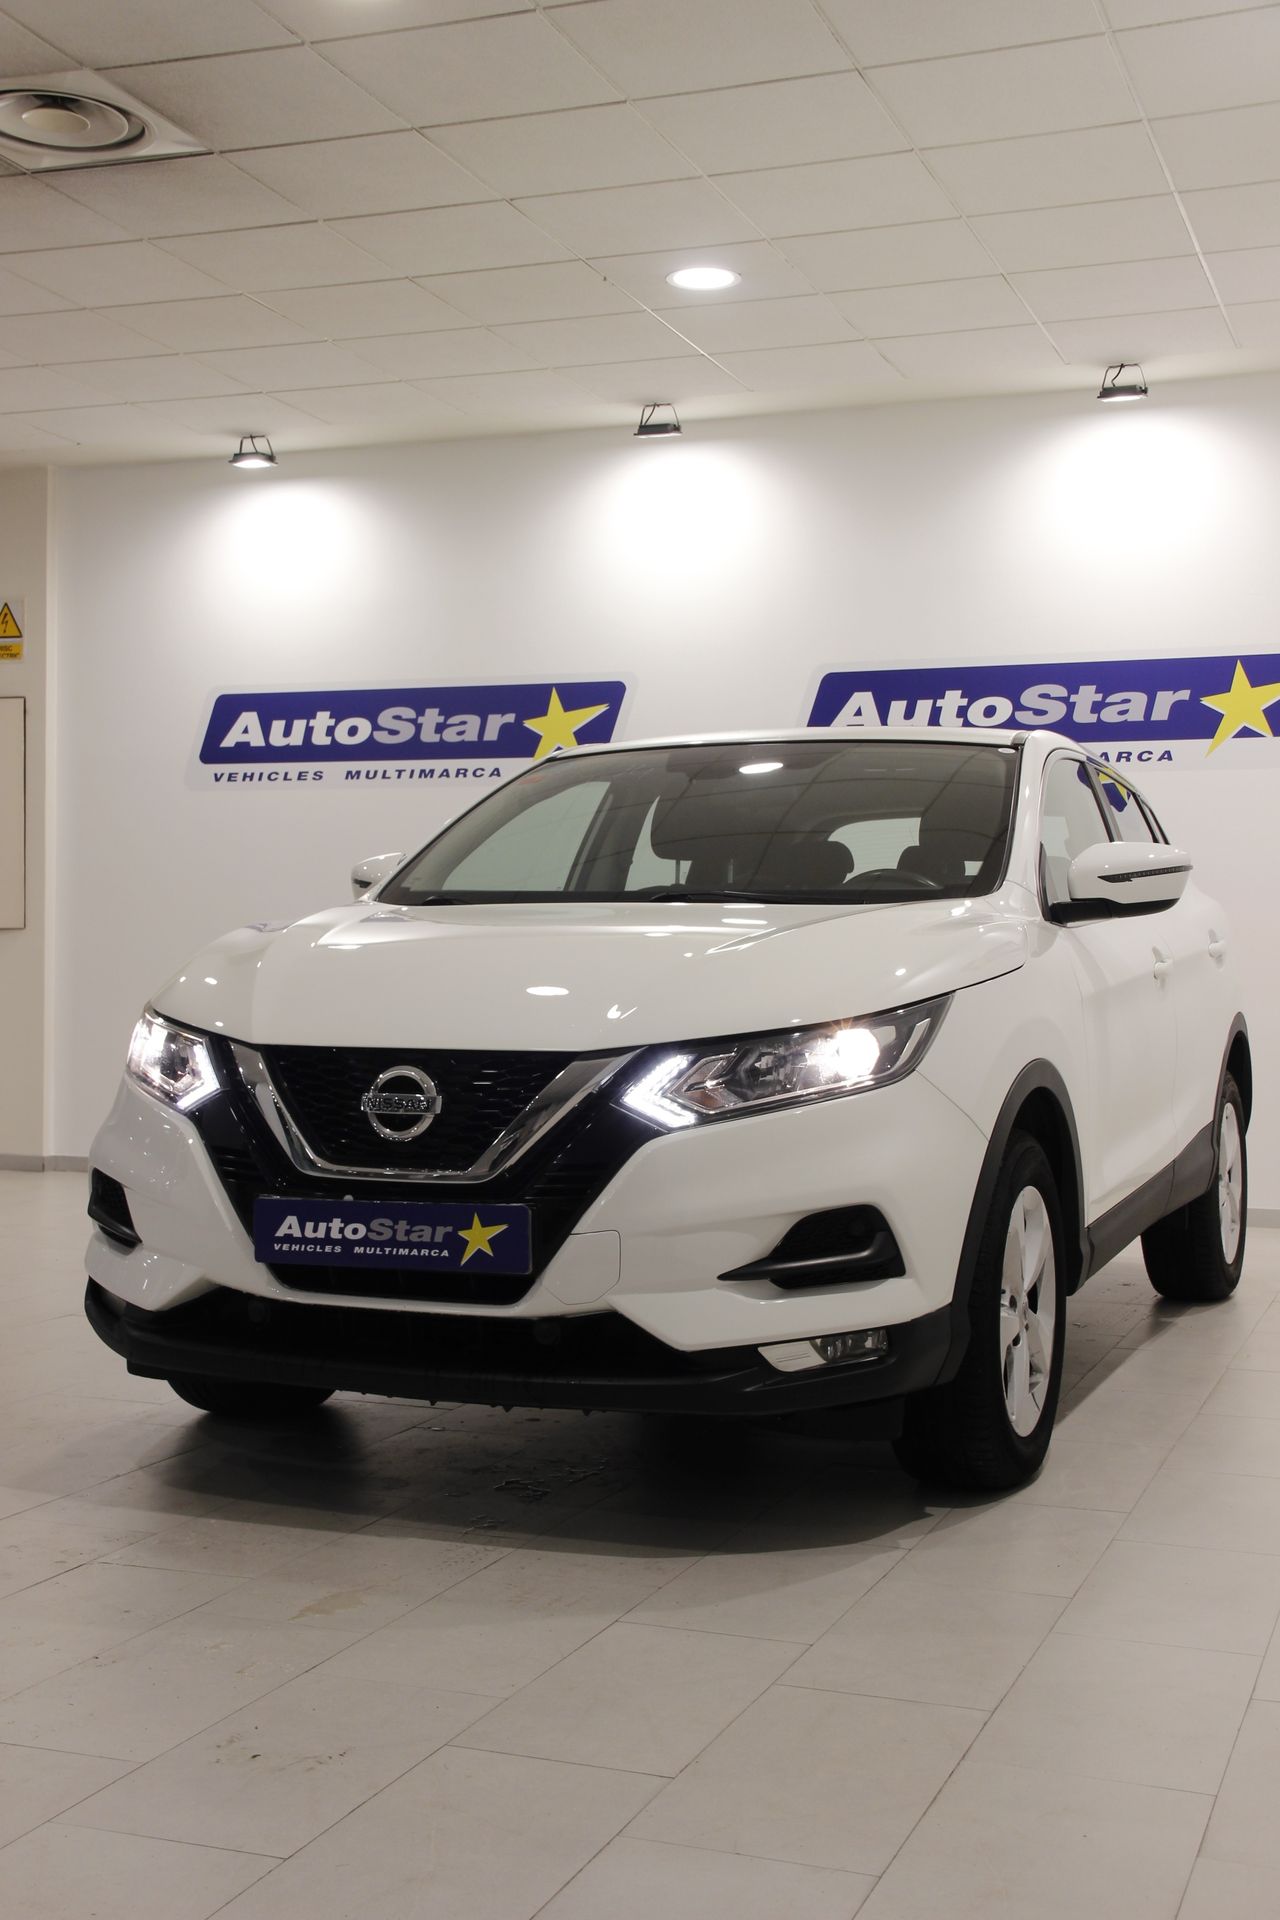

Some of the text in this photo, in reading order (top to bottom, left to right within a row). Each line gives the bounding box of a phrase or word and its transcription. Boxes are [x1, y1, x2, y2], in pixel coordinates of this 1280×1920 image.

[829, 683, 1191, 727] AutoStar
[219, 706, 516, 748] AutoStar
[1098, 749, 1174, 763] ARCA
[213, 766, 502, 783] VEHICLES MULTIMARCA
[274, 1215, 453, 1243] AutoStar
[273, 1243, 449, 1257] VEHICLES MULTIMARCA
